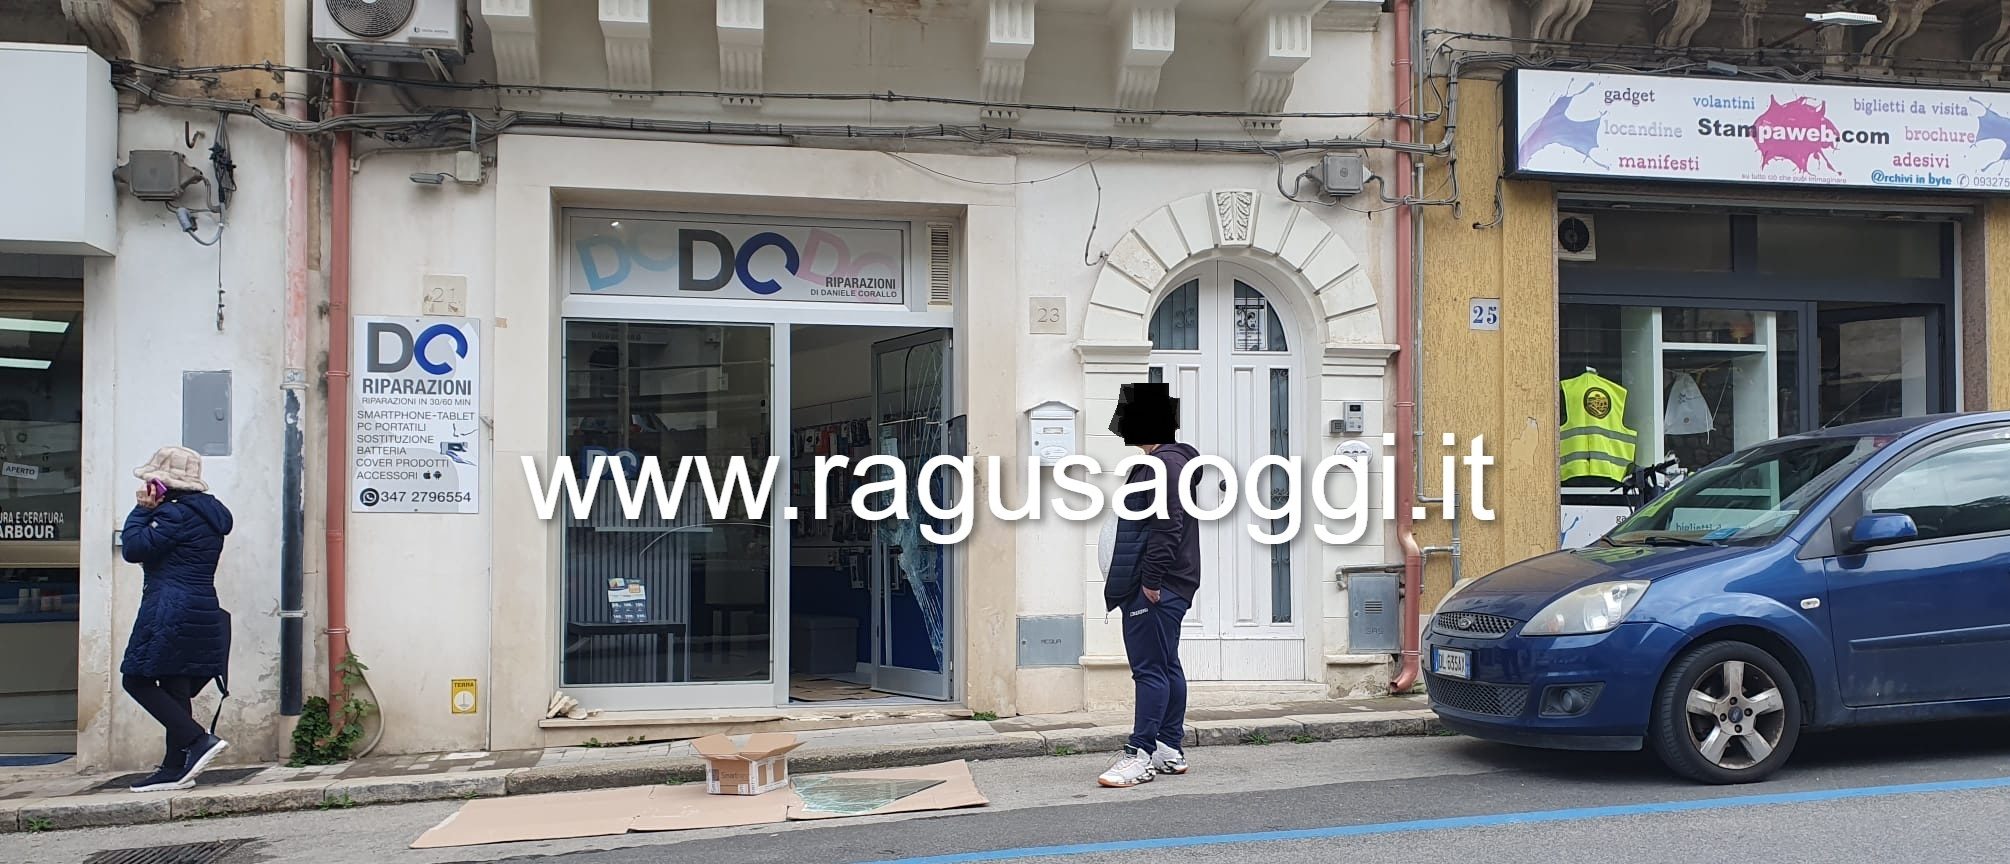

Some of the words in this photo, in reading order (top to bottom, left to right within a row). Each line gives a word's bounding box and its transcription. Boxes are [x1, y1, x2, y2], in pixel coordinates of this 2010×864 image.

[1604, 88, 1655, 105] gadget
[1693, 95, 1755, 110] volantini
[1854, 98, 1905, 116] biglietti
[1910, 101, 1926, 114] da
[1932, 103, 1968, 116] visita
[1604, 120, 1683, 138] locandine
[1698, 118, 1890, 145] Stampaweb.com
[1905, 126, 1975, 143] brochure
[1619, 155, 1700, 171] manifesti
[1893, 152, 1950, 168] adesivi
[1871, 170, 1913, 184] @rchivi
[1916, 174, 1925, 184] in
[1928, 172, 1952, 186] byte
[825, 277, 896, 290] RIPARAZIONI
[821, 289, 856, 297] DANIELE
[1037, 307, 1060, 323] 23
[1472, 305, 1497, 324] 25
[362, 378, 472, 396] RIPARAZIONI
[362, 397, 417, 406] RIPARAZIONI
[419, 398, 428, 406] IN
[429, 398, 453, 406] 30/60
[454, 398, 471, 406] MIN
[357, 410, 475, 421] SMARTPHONE-TABLET
[357, 422, 372, 432] PC
[375, 423, 426, 432] PORTATILI
[357, 435, 435, 444] SOSTITUZIONE
[357, 446, 407, 455] BATTERIA
[356, 458, 393, 467] COVER
[395, 458, 450, 468] PRODOTTI
[6, 465, 36, 476] APERTO
[356, 471, 418, 480] ACCESSORI
[380, 491, 407, 502] 347
[411, 491, 472, 502] 2796554
[16, 511, 21, 523] E
[23, 511, 65, 524] CERATURA
